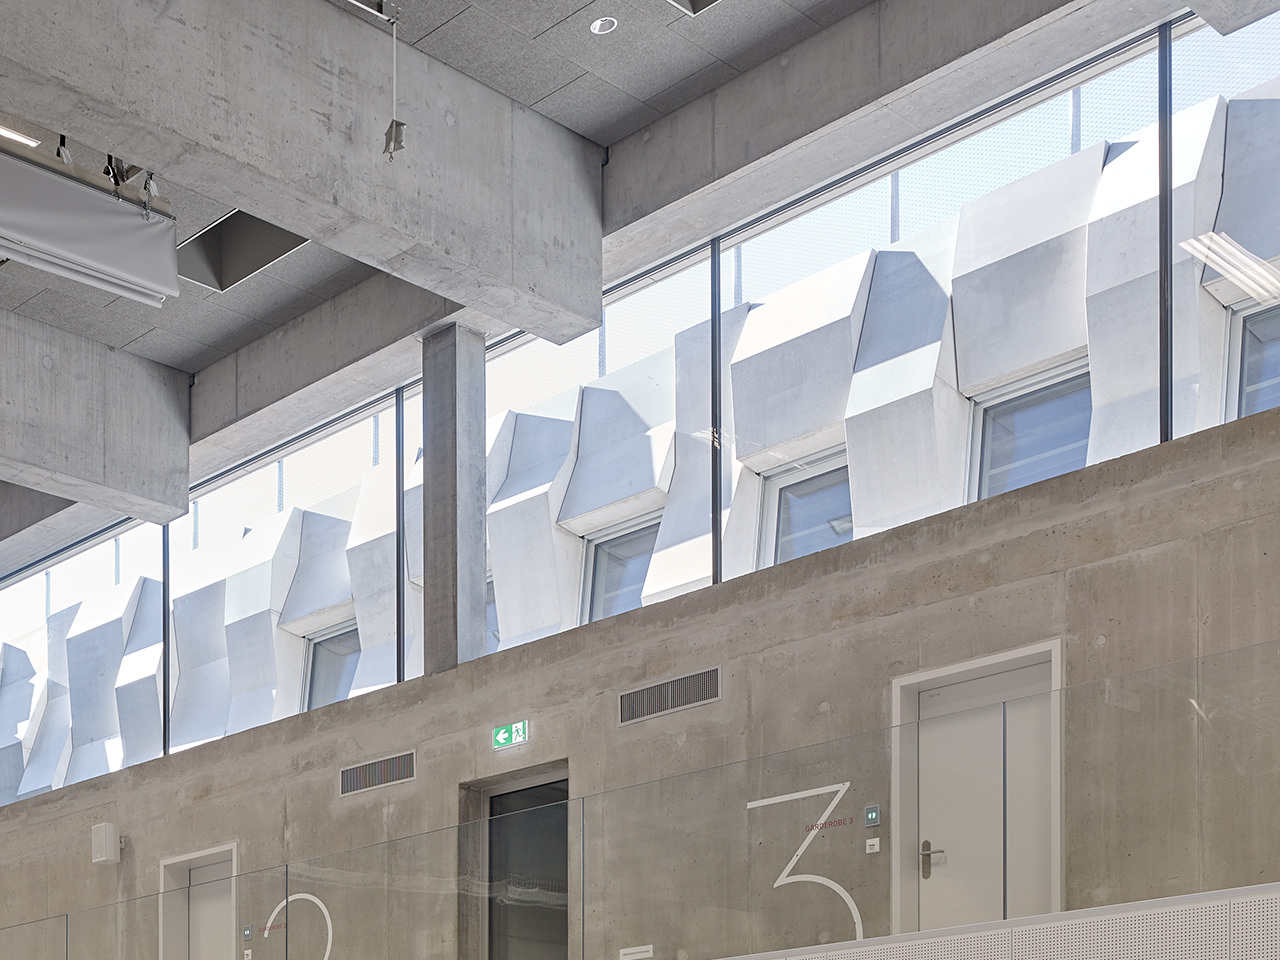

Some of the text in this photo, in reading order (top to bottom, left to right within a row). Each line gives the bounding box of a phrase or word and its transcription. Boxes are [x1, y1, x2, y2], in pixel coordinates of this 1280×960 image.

[747, 782, 863, 940] 3
[804, 816, 854, 832] GARDEROBE 3
